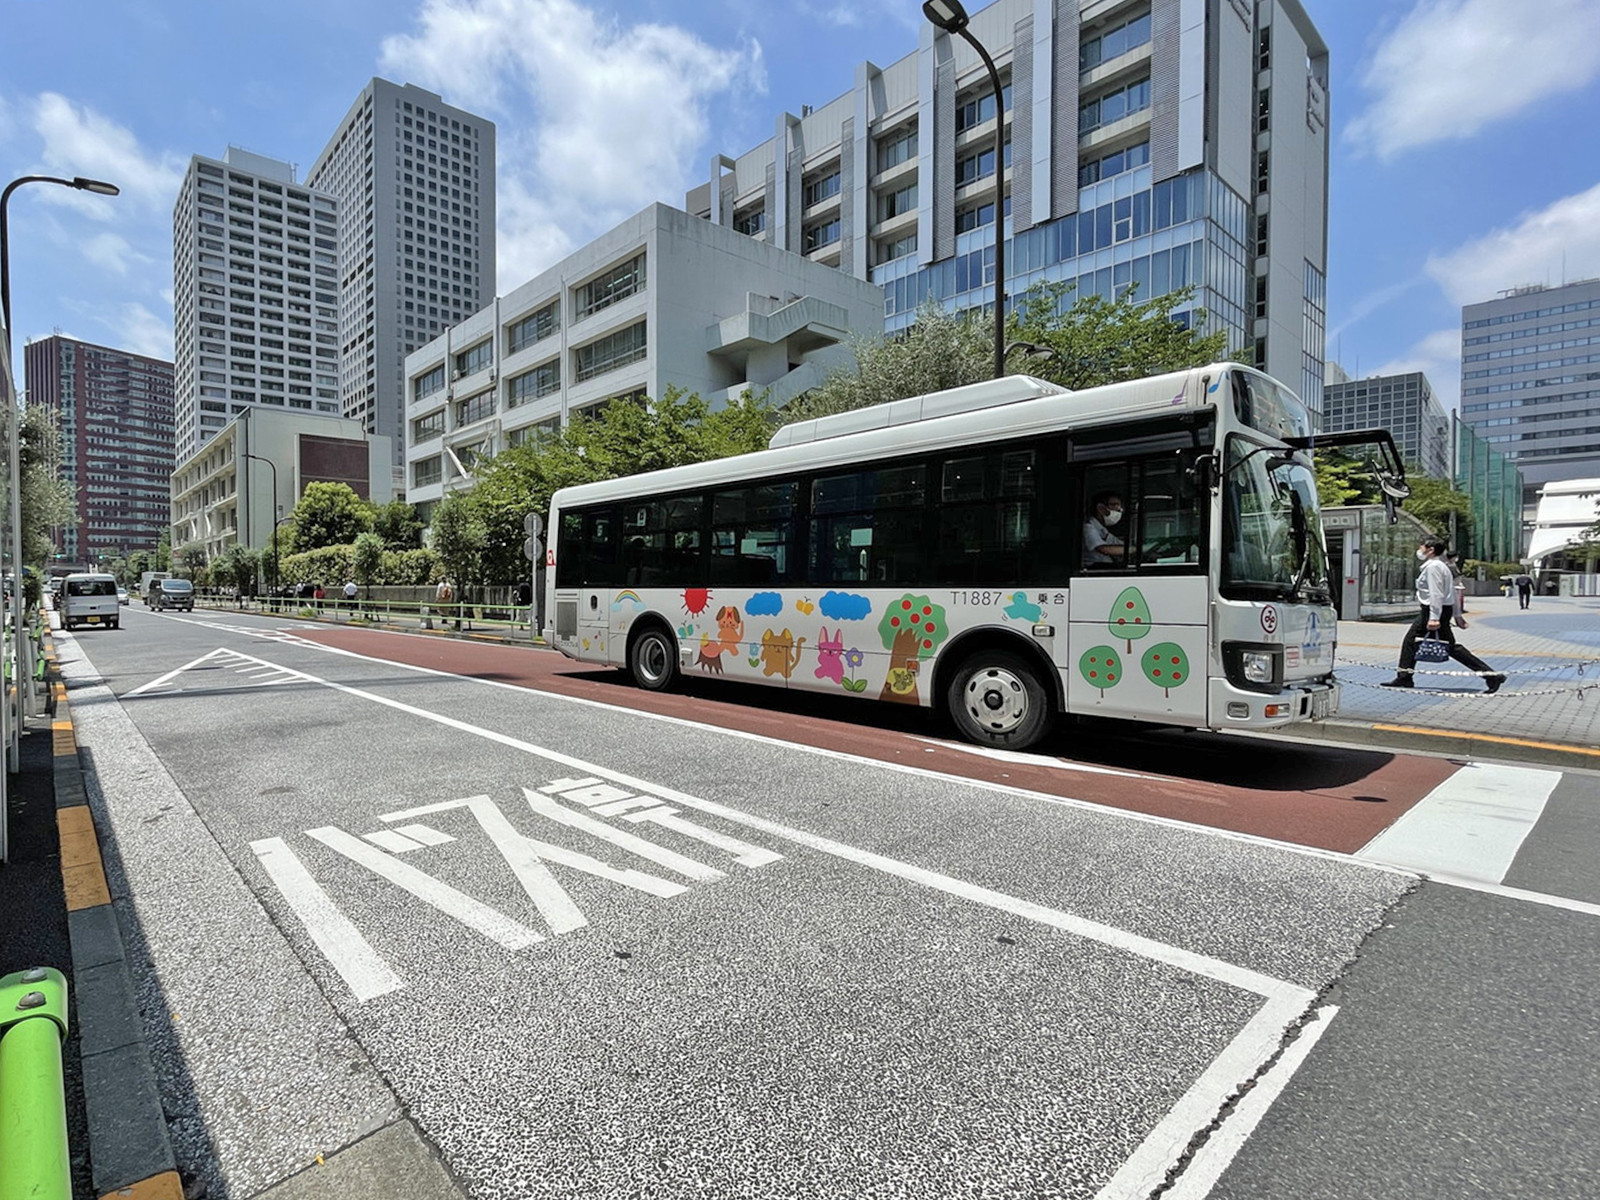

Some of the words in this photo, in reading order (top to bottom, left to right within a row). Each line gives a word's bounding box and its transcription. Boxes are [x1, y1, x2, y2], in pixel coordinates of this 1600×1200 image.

[950, 590, 1003, 606] T1887
[1037, 592, 1065, 605] 乗合
[249, 776, 784, 1002] バス停
